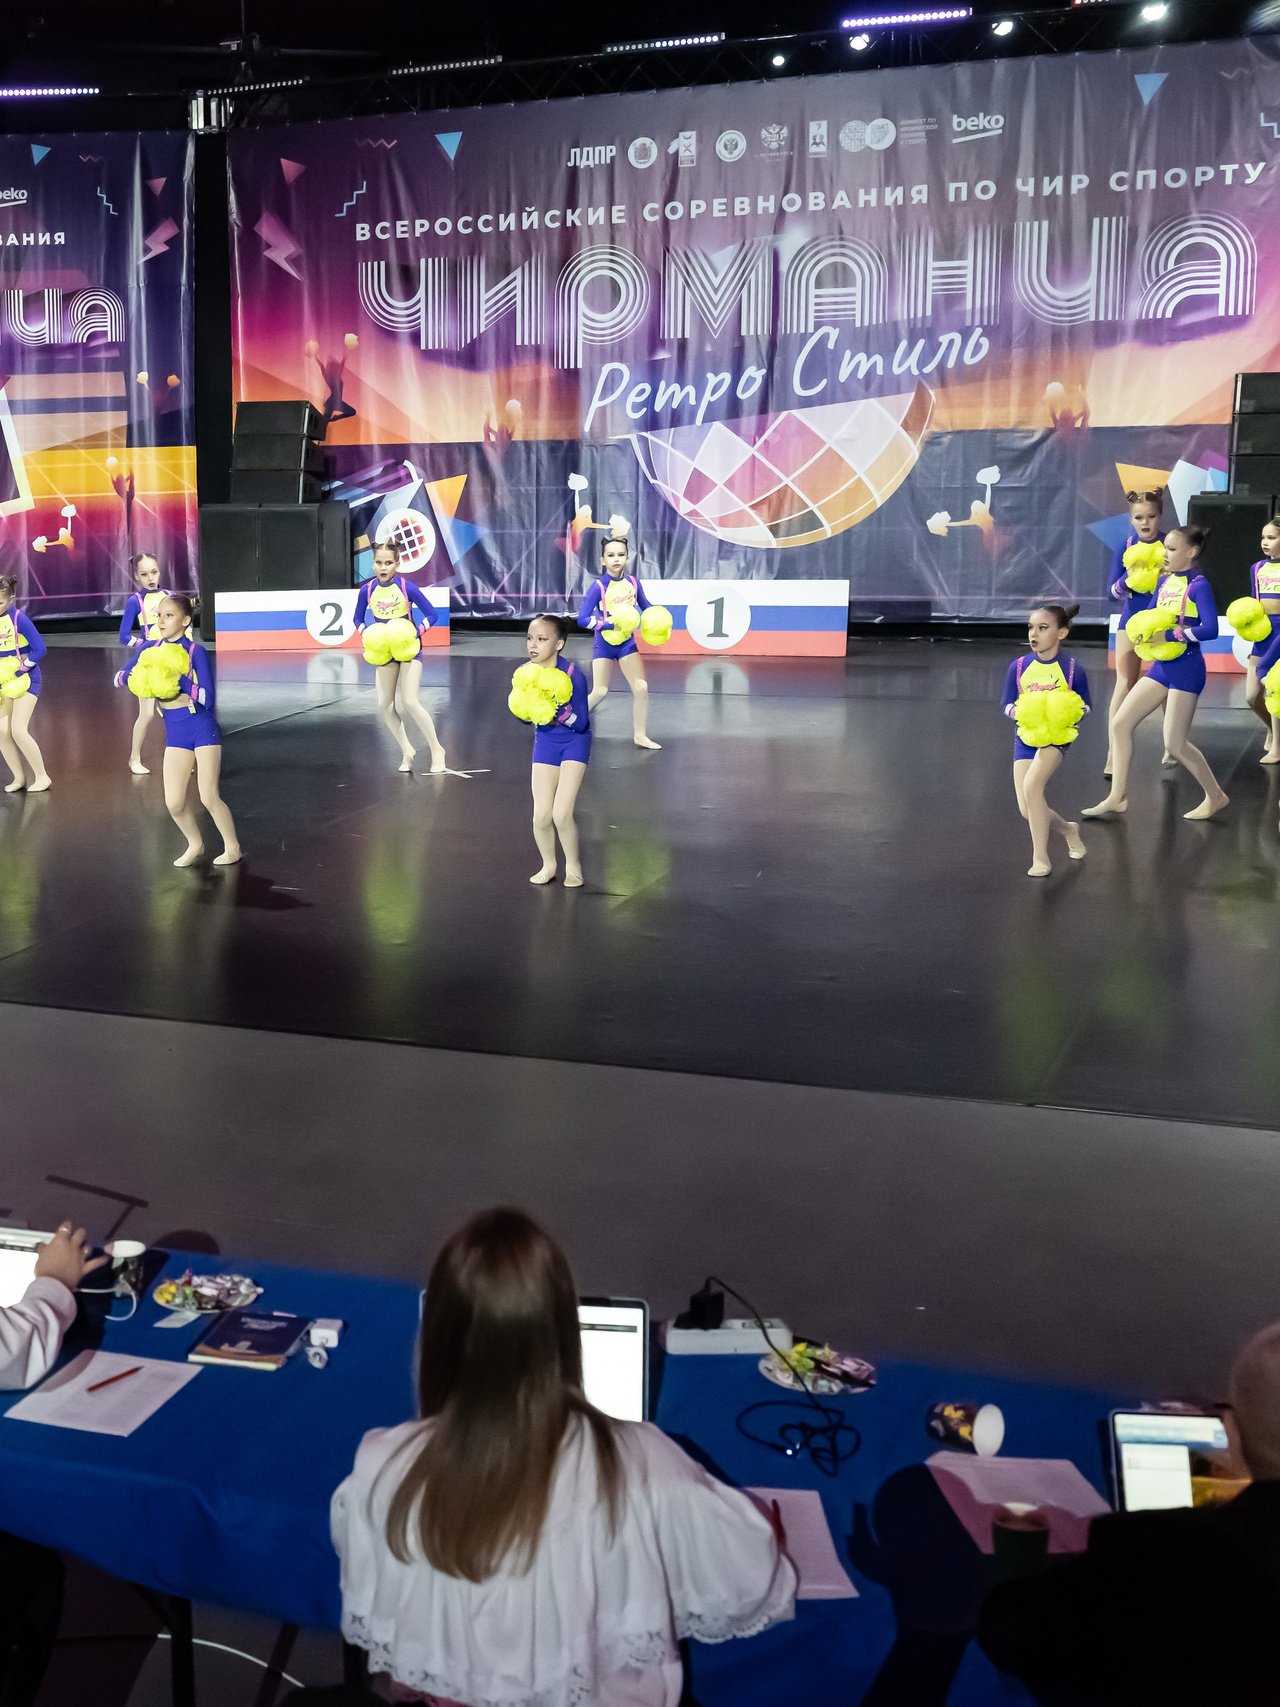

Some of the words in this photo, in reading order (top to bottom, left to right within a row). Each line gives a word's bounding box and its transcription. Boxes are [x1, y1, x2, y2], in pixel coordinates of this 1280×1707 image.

[952, 112, 1005, 131] beko
[567, 145, 616, 168] ЛДПР
[355, 204, 626, 241] ВСЕРОССИЙСКИЕ
[643, 184, 929, 222] СОРЕВНОВАНИЯ
[949, 179, 997, 202] ПО
[1016, 173, 1090, 197] ЧИР
[1110, 162, 1267, 192] СПОРТУ
[584, 360, 767, 430] Ретро
[792, 325, 990, 397] Стиль
[319, 602, 345, 637] 2
[706, 596, 731, 639] 1
